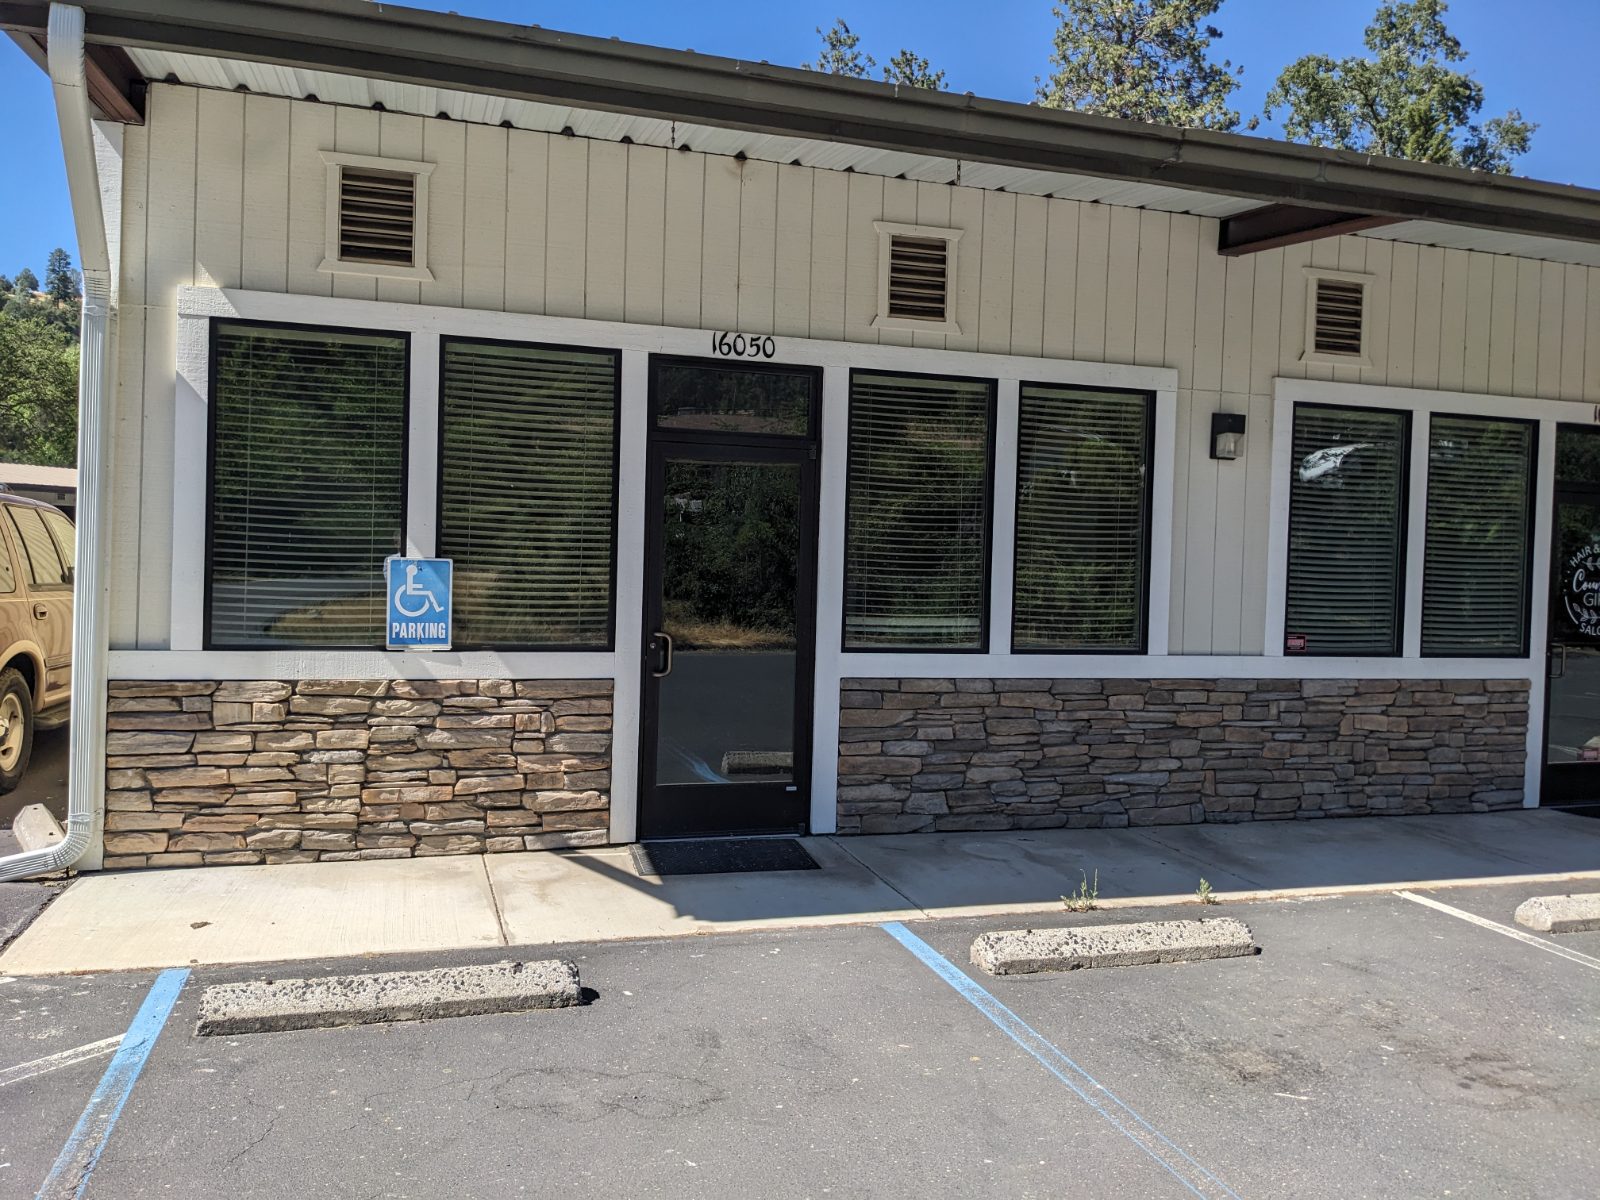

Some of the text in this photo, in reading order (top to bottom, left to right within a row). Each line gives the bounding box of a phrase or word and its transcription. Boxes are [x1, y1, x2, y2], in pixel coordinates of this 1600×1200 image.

[712, 331, 776, 359] 16050
[1569, 545, 1593, 568] HAIR
[392, 622, 446, 639] PARKING
